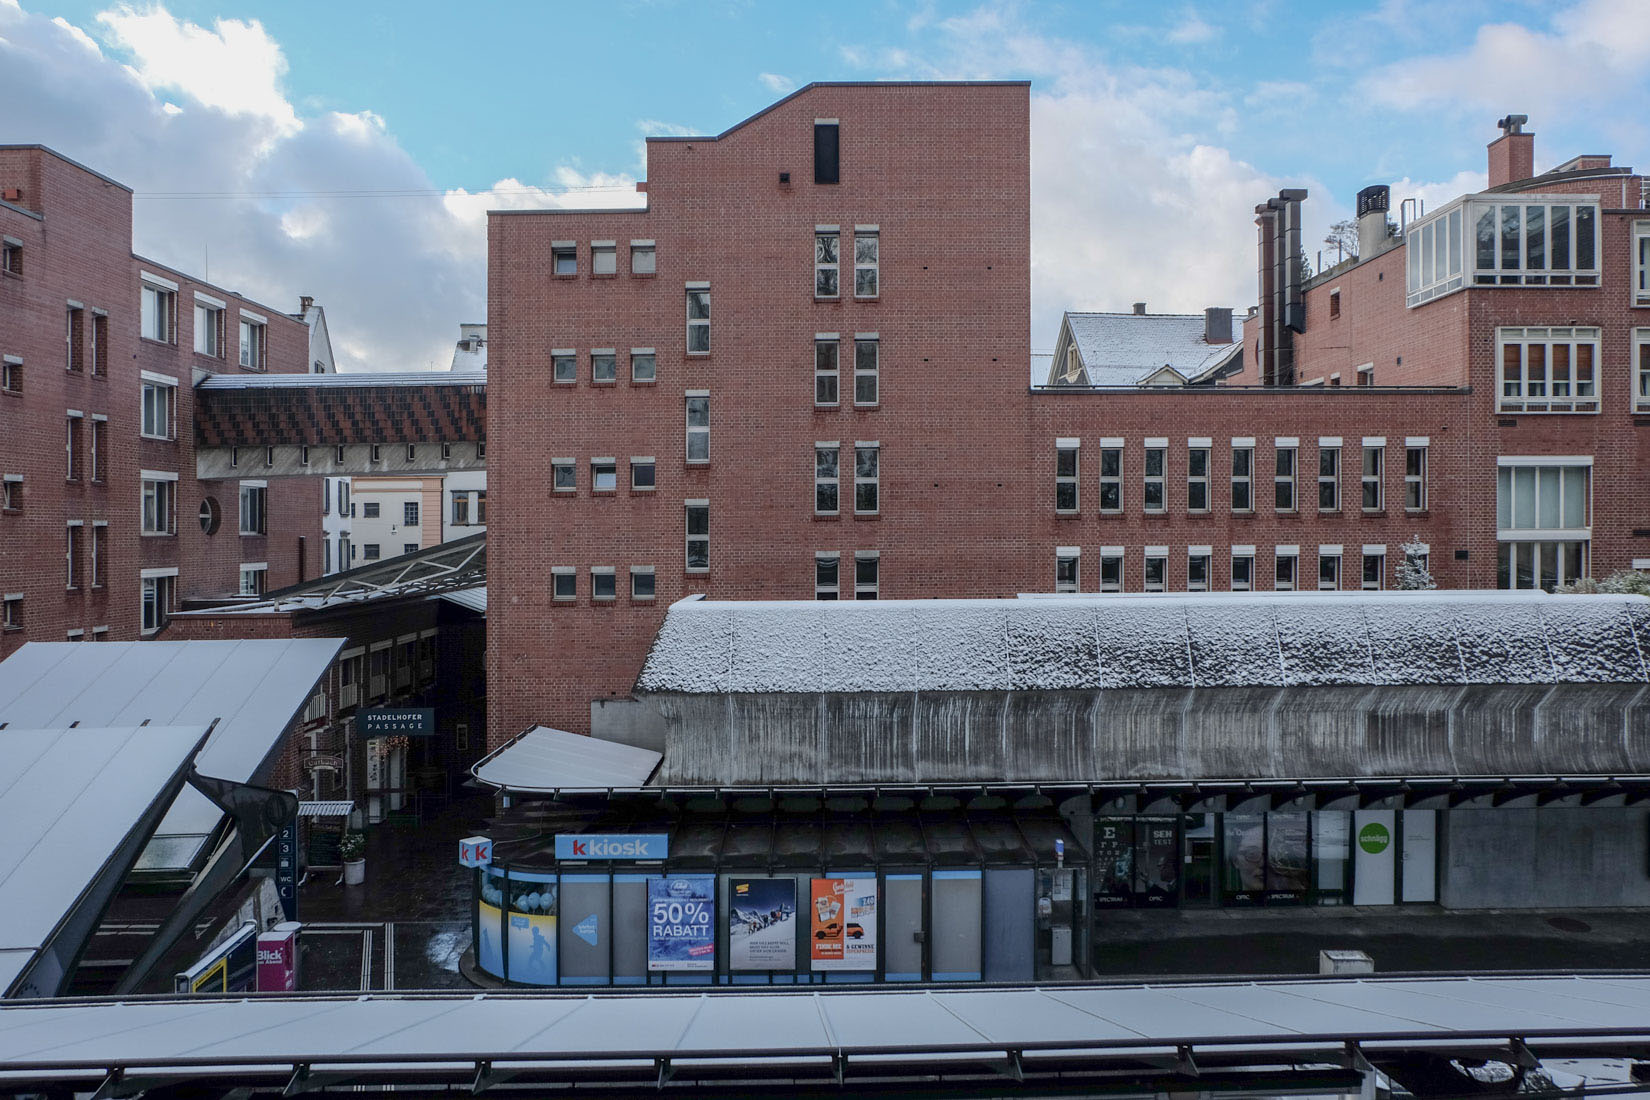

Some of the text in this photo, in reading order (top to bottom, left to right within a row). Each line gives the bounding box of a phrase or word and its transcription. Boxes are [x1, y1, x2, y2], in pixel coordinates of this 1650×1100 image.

[367, 713, 423, 721] STADELHOFER
[367, 722, 423, 730] PASSAGE
[282, 829, 289, 838] 2
[1103, 827, 1116, 839] E
[1153, 830, 1173, 838] SEH
[282, 844, 289, 853] 3
[461, 844, 469, 861] k
[475, 845, 488, 861] k
[572, 839, 649, 856] k kiosk
[653, 902, 709, 924] 50%
[653, 925, 709, 937] RABATT
[258, 949, 282, 960] Blick
